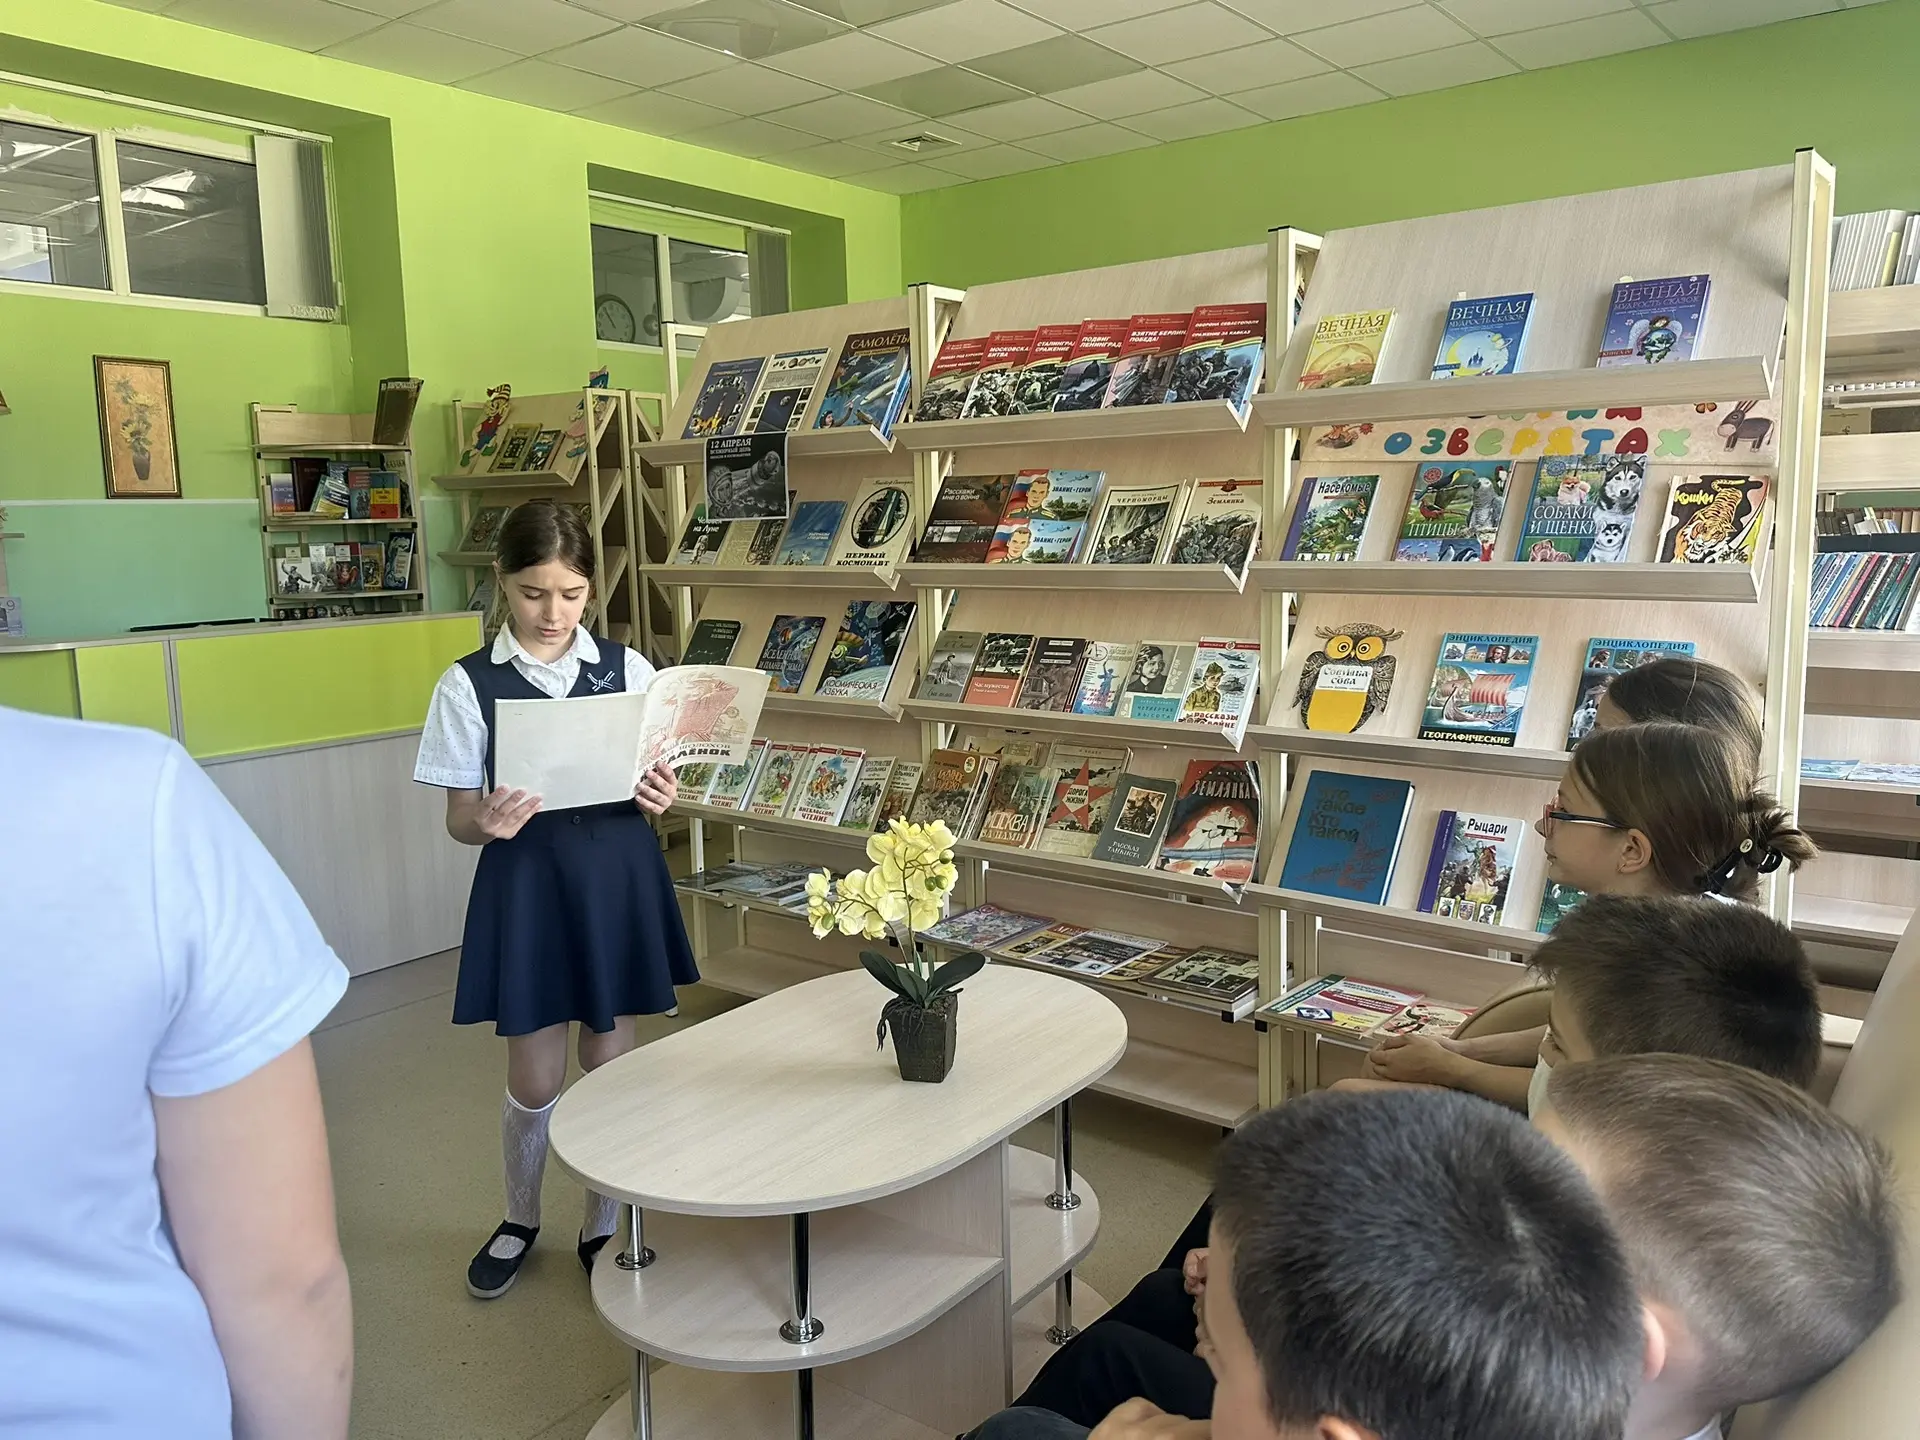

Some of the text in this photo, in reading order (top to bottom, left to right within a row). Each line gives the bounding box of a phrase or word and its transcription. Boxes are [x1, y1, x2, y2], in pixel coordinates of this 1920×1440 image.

[1616, 283, 1701, 304] ВЕЧНАЯ
[1450, 300, 1528, 320] ВЕЧНАЯ
[1316, 314, 1386, 334] ВЕЧНАЯ
[1449, 318, 1491, 329] МУДРОСТЬ
[1491, 314, 1525, 324] СКАЗОК
[1315, 330, 1353, 340] МУДРОСТЬ
[850, 334, 910, 350] САМОЛЁТЫ
[710, 438, 752, 449] 12 АПРЕЛЯ
[1384, 427, 1692, 457] О ЗВЕРЯТАХ
[1317, 480, 1371, 494] Насекомые
[1116, 494, 1169, 504] ЧЕРНОМОРЦЫ
[1206, 497, 1245, 505] Землянка
[1533, 504, 1594, 519] СОБАКИ
[702, 524, 720, 534] Луне
[1408, 523, 1459, 538] ПТИЦЫ
[1529, 520, 1599, 536] И ЩЕНКИ
[844, 552, 886, 560] ПЕРВЫЙ
[1448, 633, 1533, 644] ЭНЦИКЛОПЕДИЯ
[1594, 639, 1689, 651] ЭНЦИКЛОПЕДИЯ
[824, 679, 878, 690] КОСМИЧЕСКАЯ
[821, 687, 849, 696] АЗБУКА
[1422, 730, 1511, 744] ГЕОГРАФИЧЕСКИЕ
[679, 741, 731, 750] ШОЛОХОВ
[1068, 787, 1088, 797] ДОРОГА
[1192, 780, 1252, 800] ЗЕМЛЯНКА
[711, 800, 733, 808] ЧТЕНИЕ
[1065, 796, 1087, 805] ЖИЗНИ
[754, 807, 776, 816] ЧТЕНИЕ
[801, 813, 828, 823] ЧТЕНИЕ
[985, 811, 1029, 832] МОСКВА
[1467, 817, 1508, 835] Рыцари
[1113, 841, 1140, 852] РАССКАЗ
[1107, 846, 1141, 859] ТАНКИСТА
